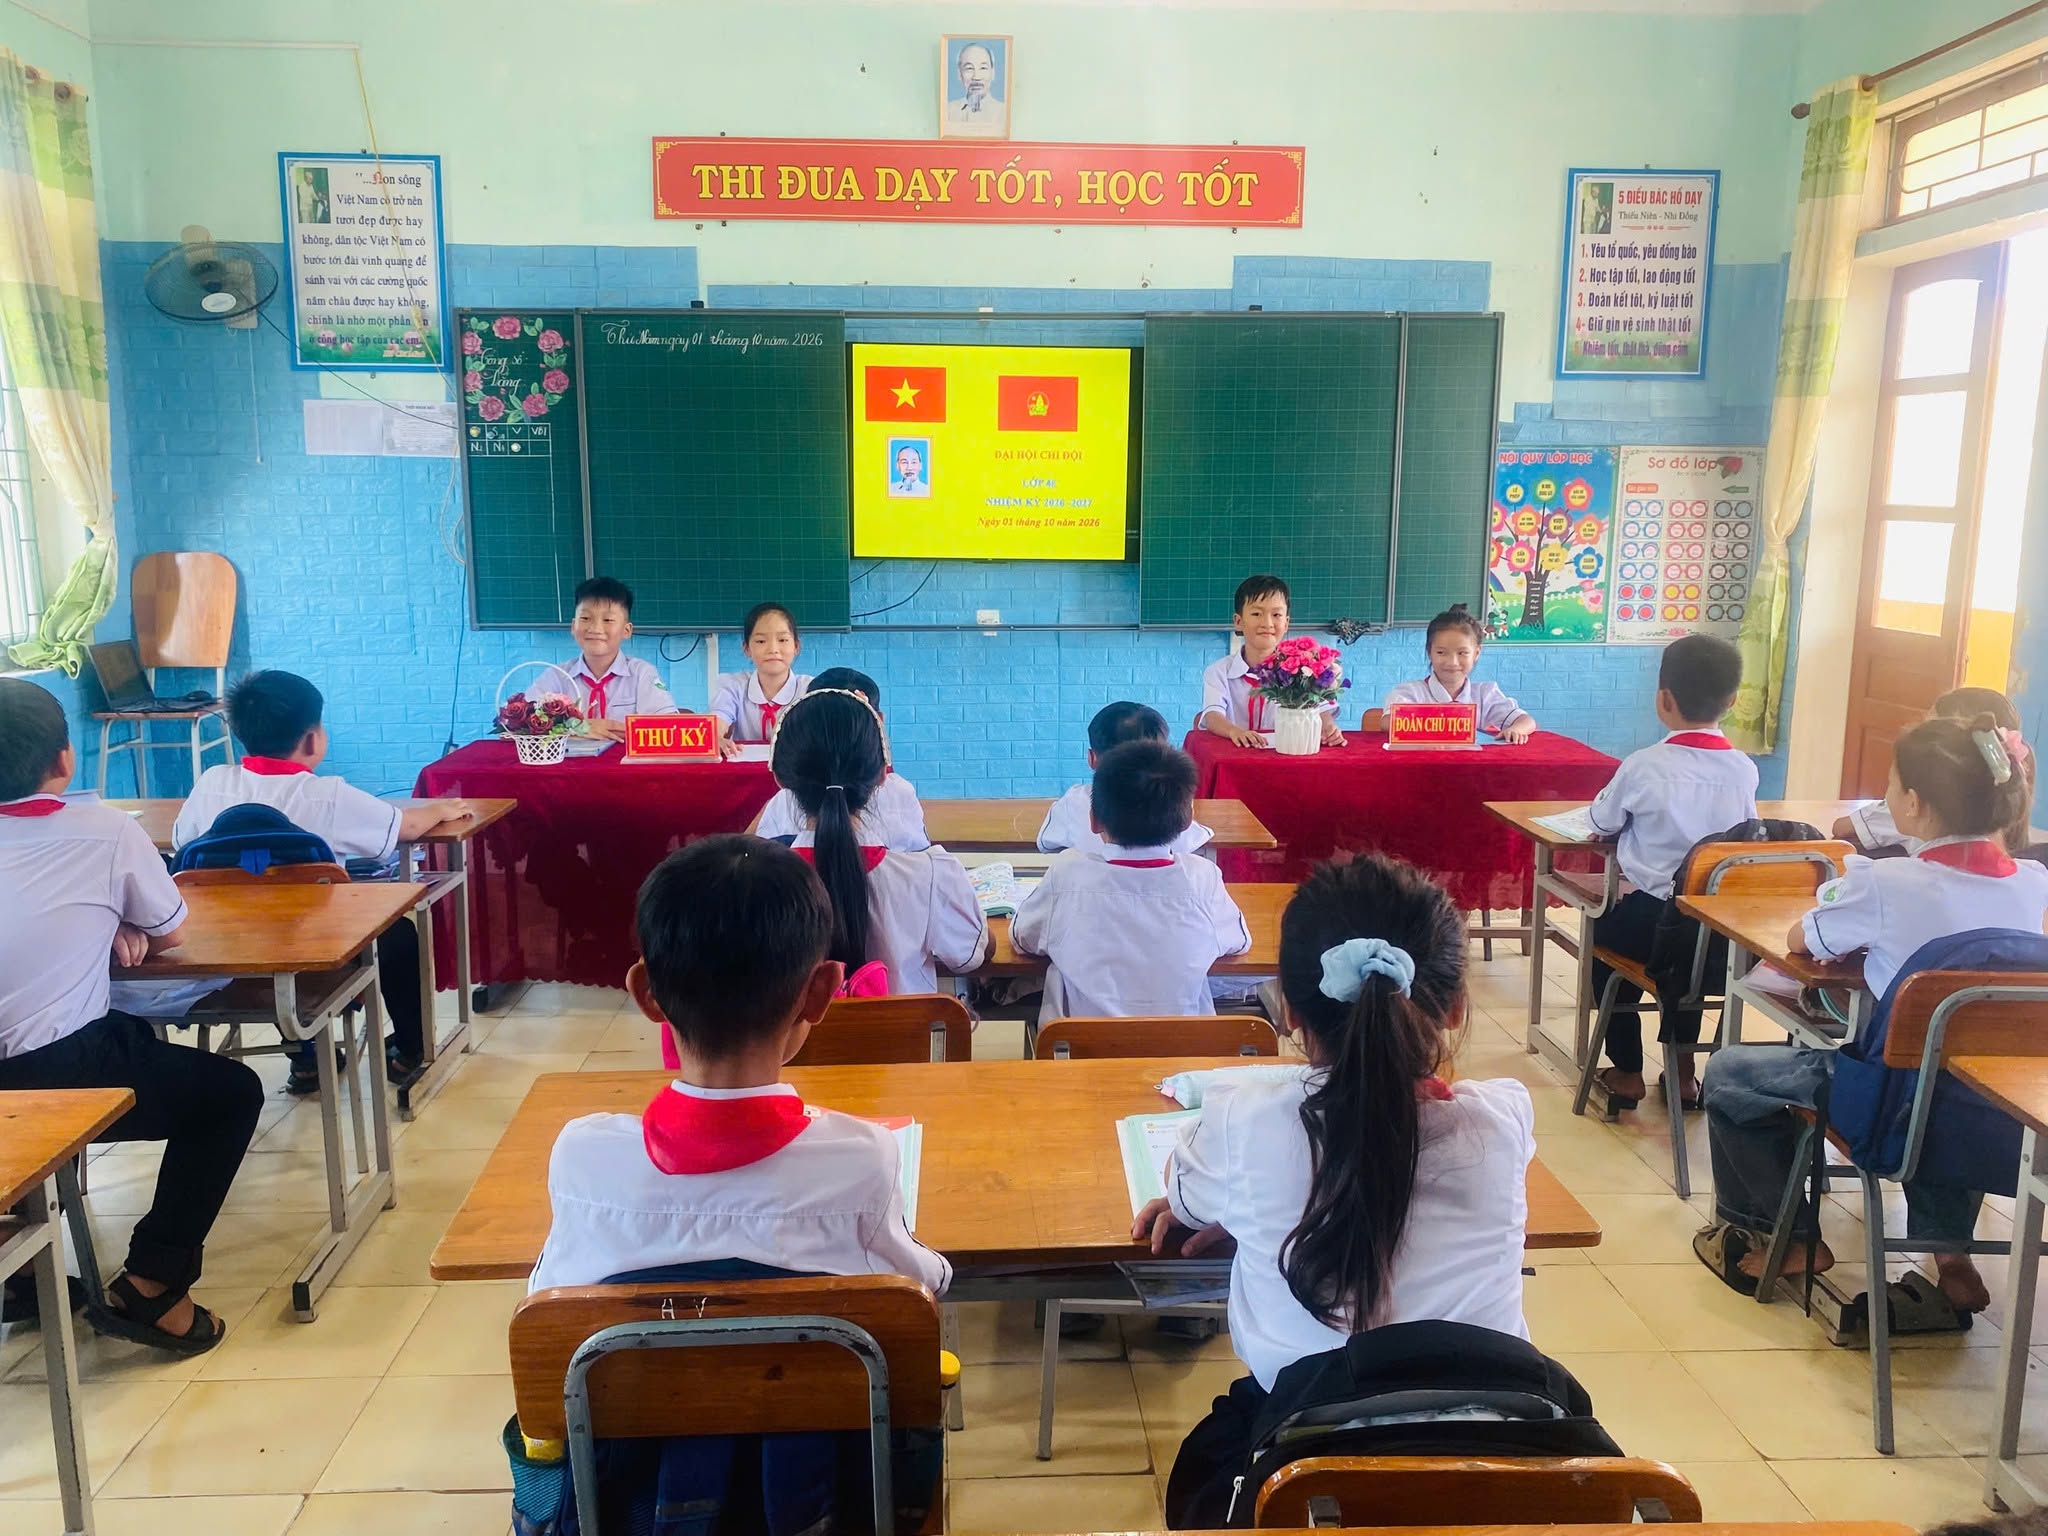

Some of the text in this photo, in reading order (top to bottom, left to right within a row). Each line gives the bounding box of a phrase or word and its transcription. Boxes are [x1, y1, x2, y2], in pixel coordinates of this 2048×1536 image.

[398, 174, 422, 188] sông
[691, 154, 1259, 214] THI ĐUA DẠY TỐT, HỌC TỐT
[337, 194, 355, 207] Việt
[357, 194, 378, 205] Nam
[1618, 190, 1625, 204] 5
[1684, 190, 1703, 208] DẠY
[358, 215, 377, 228] đẹp
[406, 216, 423, 229] hay
[1664, 210, 1677, 220] Nhi
[302, 234, 426, 247] không, dân tộc Việt Nam có
[1581, 243, 1588, 258] 1.
[1591, 243, 1606, 258] Yêu
[1618, 241, 1640, 260] quốc,
[1642, 243, 1658, 260] yêu
[361, 255, 383, 266] vinh
[385, 257, 413, 269] quang
[415, 254, 427, 266] để
[304, 275, 325, 285] sánh
[327, 275, 341, 285] vai
[343, 275, 358, 286] với
[360, 276, 375, 286] các
[407, 275, 428, 289] quốc
[1579, 266, 1696, 287] 2. Học tập tốt, lao động tốt
[353, 296, 375, 308] được
[378, 296, 394, 309] hay
[1577, 292, 1586, 307] 3.
[1613, 290, 1628, 307] kết
[1661, 292, 1678, 311] luật
[1681, 290, 1693, 308] tốt
[336, 315, 345, 325] là
[367, 316, 386, 327] một
[1623, 317, 1633, 335] vệ
[1636, 317, 1655, 332] sinh
[1658, 317, 1676, 336] thật
[1678, 315, 1691, 333] tốt
[692, 332, 703, 345] 01
[710, 329, 749, 354] tháng
[752, 333, 762, 345] 10
[763, 335, 790, 346] năm
[792, 332, 823, 346] 2026
[994, 449, 1082, 462] ĐẠI HỘI CHI ĐỘI
[1499, 450, 1593, 466] NỘI QUY LỚP HỌC
[1648, 456, 1665, 469] Sơ
[1694, 456, 1718, 471] lớp
[1022, 476, 1043, 488] LỚP
[986, 497, 1022, 508] NHIỆM
[978, 516, 1100, 528] Ngày 01 tháng 10 năm 2026
[1395, 713, 1471, 736] ĐOÀN CHỦ TỊCH
[635, 721, 707, 747] THƯ KÝ
